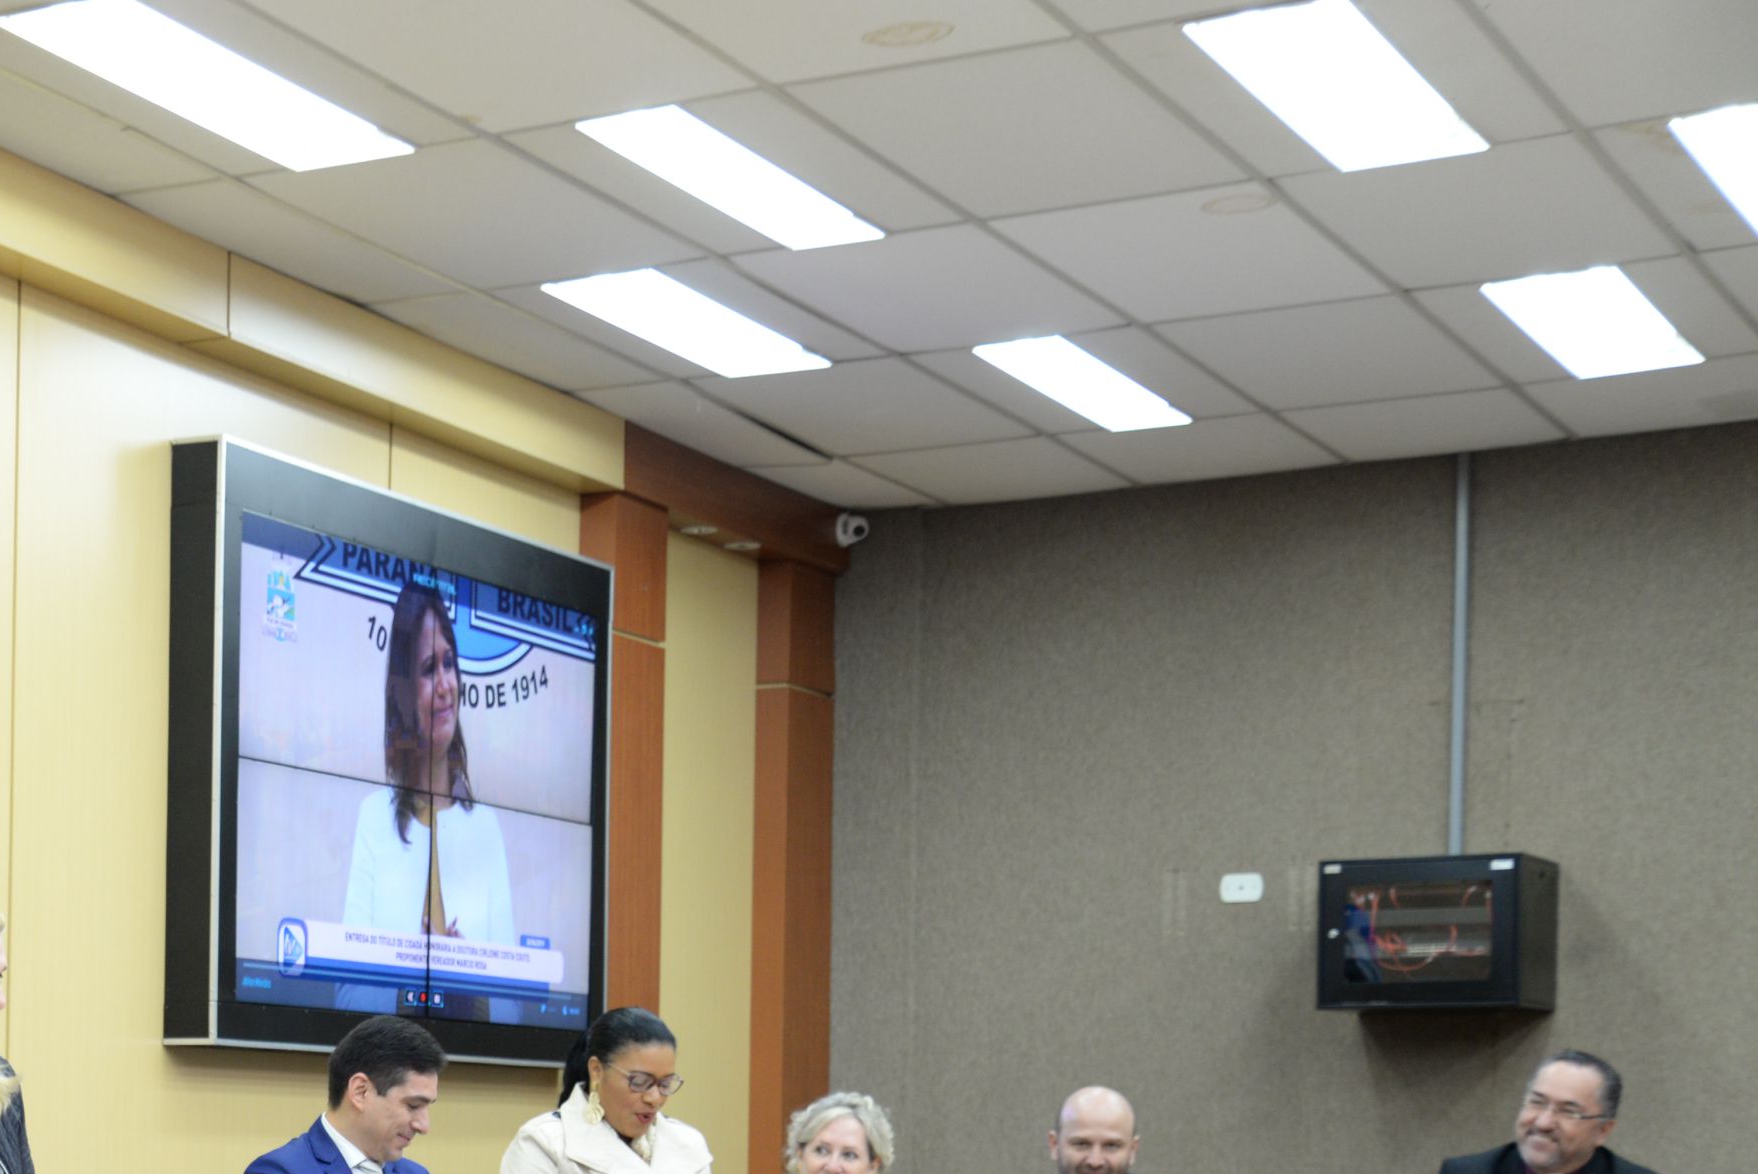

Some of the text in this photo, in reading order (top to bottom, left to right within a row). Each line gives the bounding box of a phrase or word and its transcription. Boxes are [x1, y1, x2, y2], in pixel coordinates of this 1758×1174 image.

[497, 587, 573, 634] BRASIL
[368, 616, 388, 652] 10
[485, 683, 507, 709] DE
[512, 664, 548, 703] 1914
